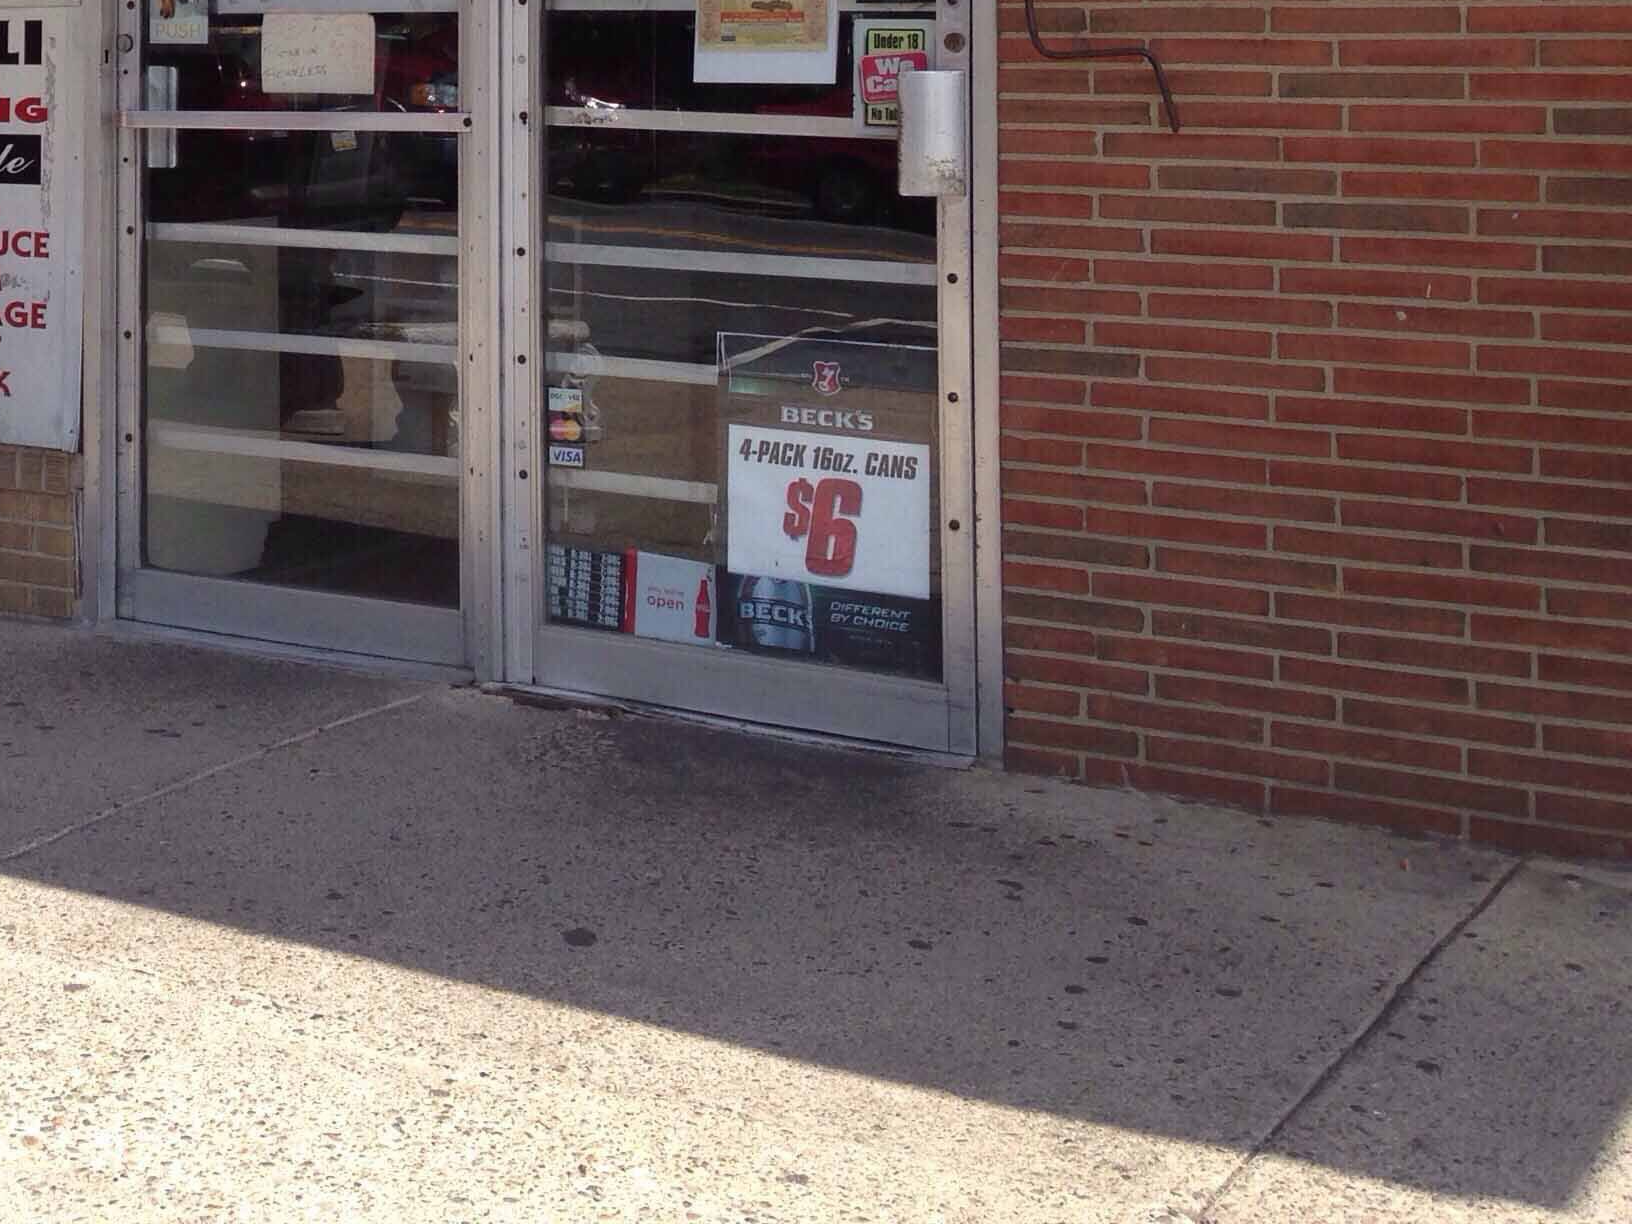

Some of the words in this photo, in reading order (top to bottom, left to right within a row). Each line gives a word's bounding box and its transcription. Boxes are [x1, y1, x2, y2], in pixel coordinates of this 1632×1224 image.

[873, 33, 905, 50] Under
[907, 33, 919, 50] 18
[553, 450, 582, 463] VISA
[739, 438, 806, 469] 4-PACK
[864, 452, 918, 480] CANS
[783, 476, 863, 577] $6
[830, 601, 911, 619] DIFFERENT
[830, 613, 850, 624] BY
[853, 615, 911, 633] CHOICE
